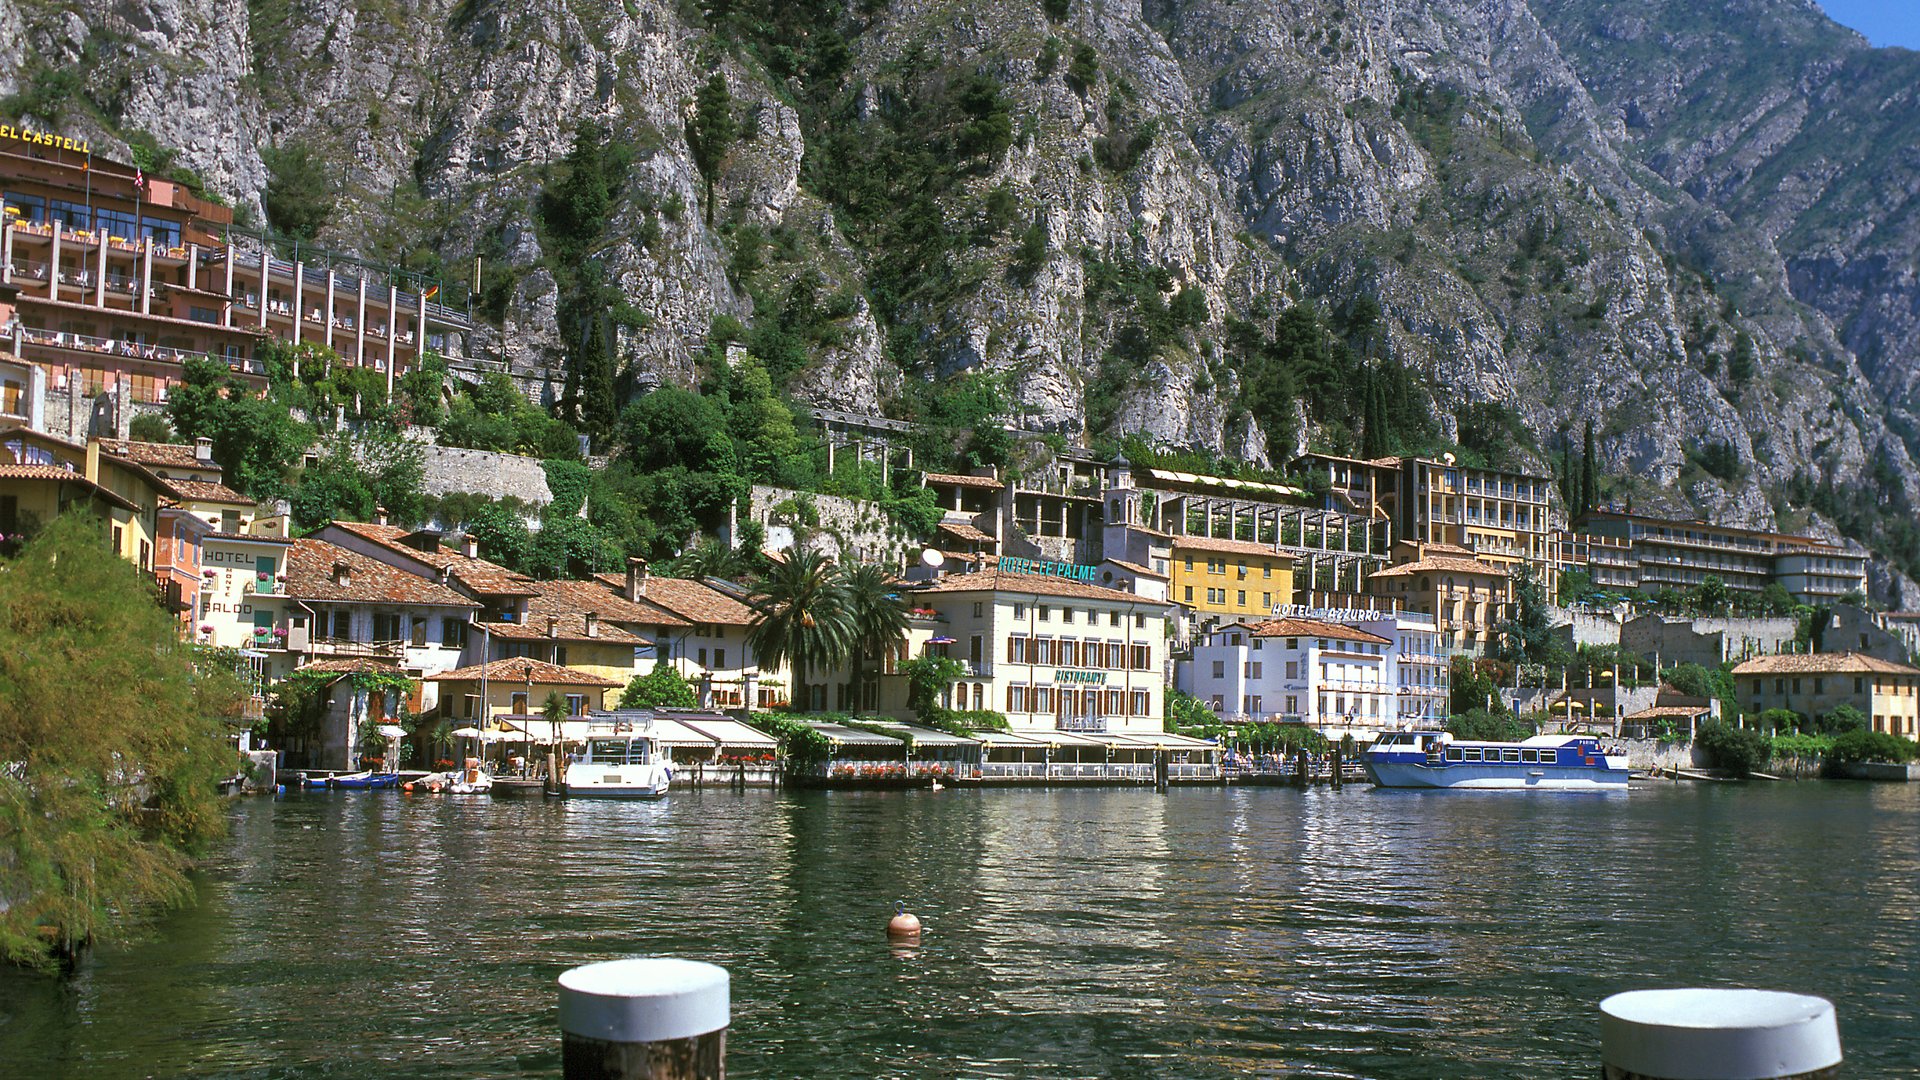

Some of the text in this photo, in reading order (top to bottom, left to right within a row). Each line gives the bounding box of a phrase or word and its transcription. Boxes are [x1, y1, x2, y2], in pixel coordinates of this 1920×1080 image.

[22, 129, 90, 153] CASTELL
[205, 551, 254, 563] HOTEL
[998, 556, 1096, 580] HOTEL LE PALME
[202, 602, 252, 614] BALDO
[1272, 602, 1311, 617] HOTEL
[1327, 608, 1380, 621] AZZURRO
[1054, 670, 1107, 685] RISTORANTE
